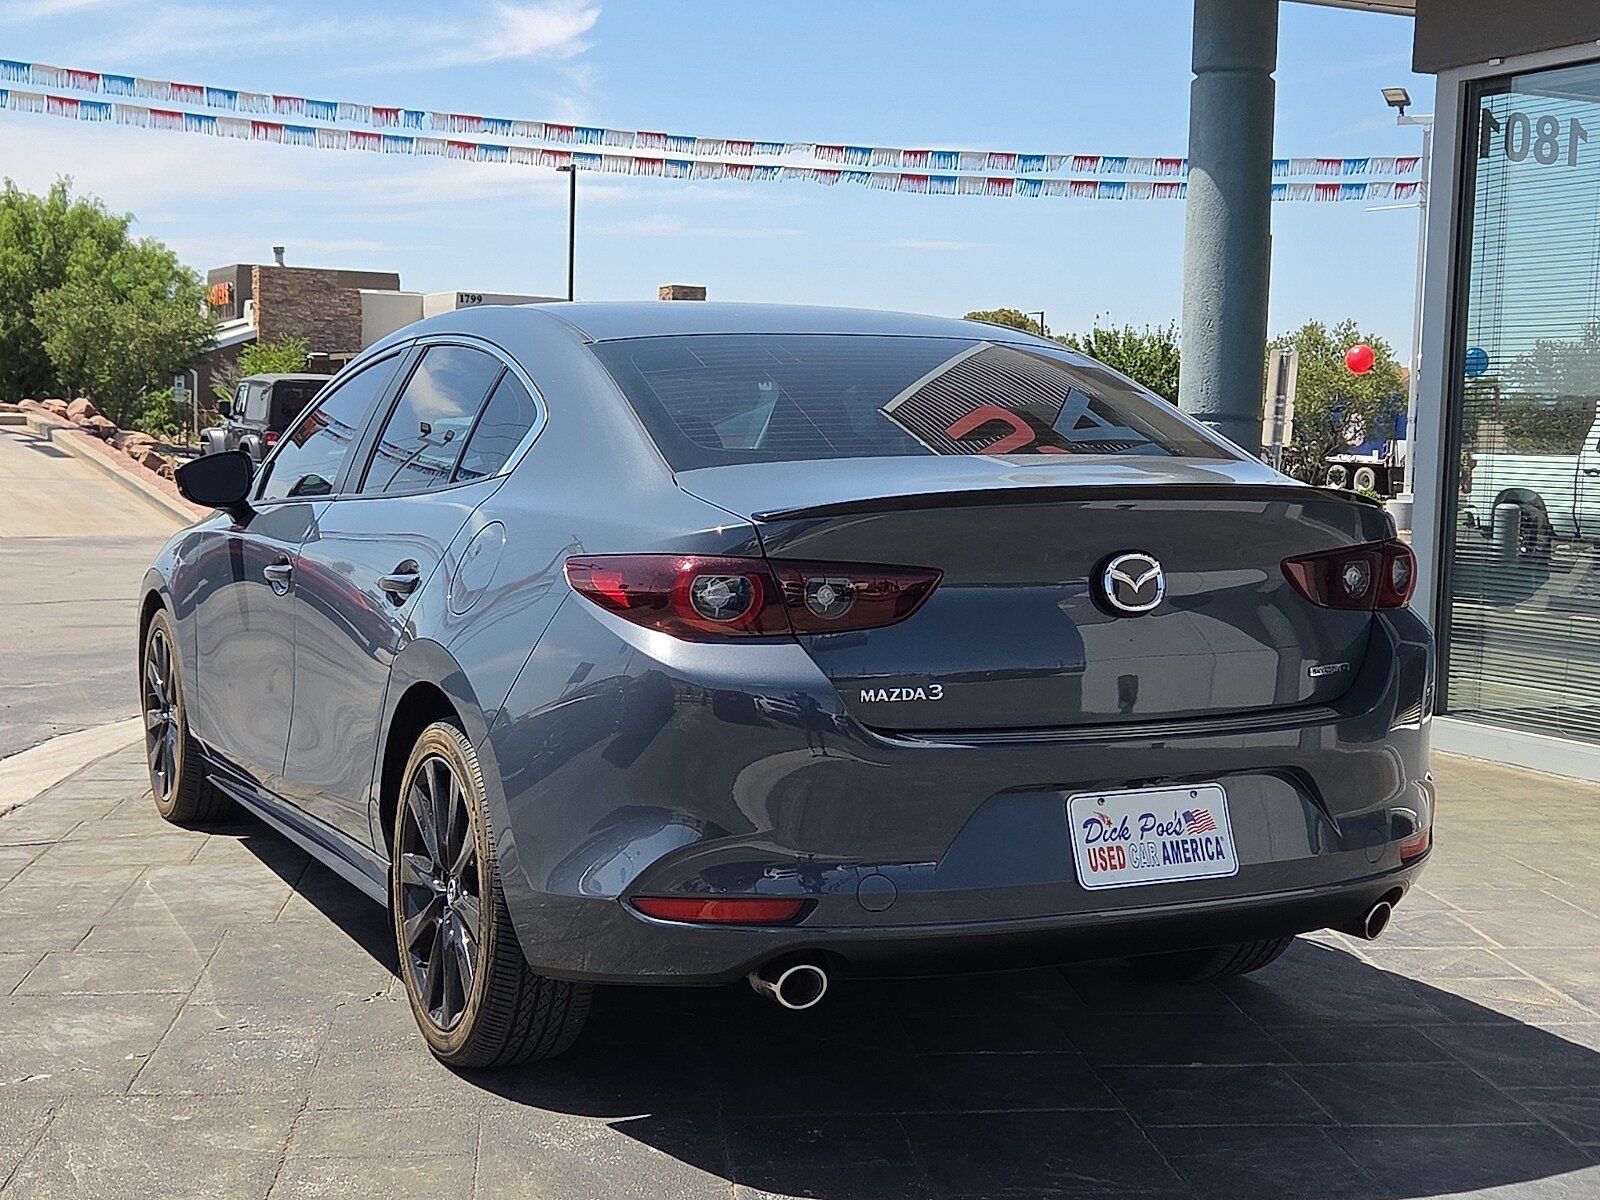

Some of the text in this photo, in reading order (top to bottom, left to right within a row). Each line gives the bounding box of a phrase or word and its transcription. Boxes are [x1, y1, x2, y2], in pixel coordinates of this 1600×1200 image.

[460, 294, 483, 304] 1799
[860, 683, 944, 702] MAZDA3
[1082, 810, 1184, 844] Dick Poe's
[1087, 836, 1226, 872] USED CAR AMERICA
